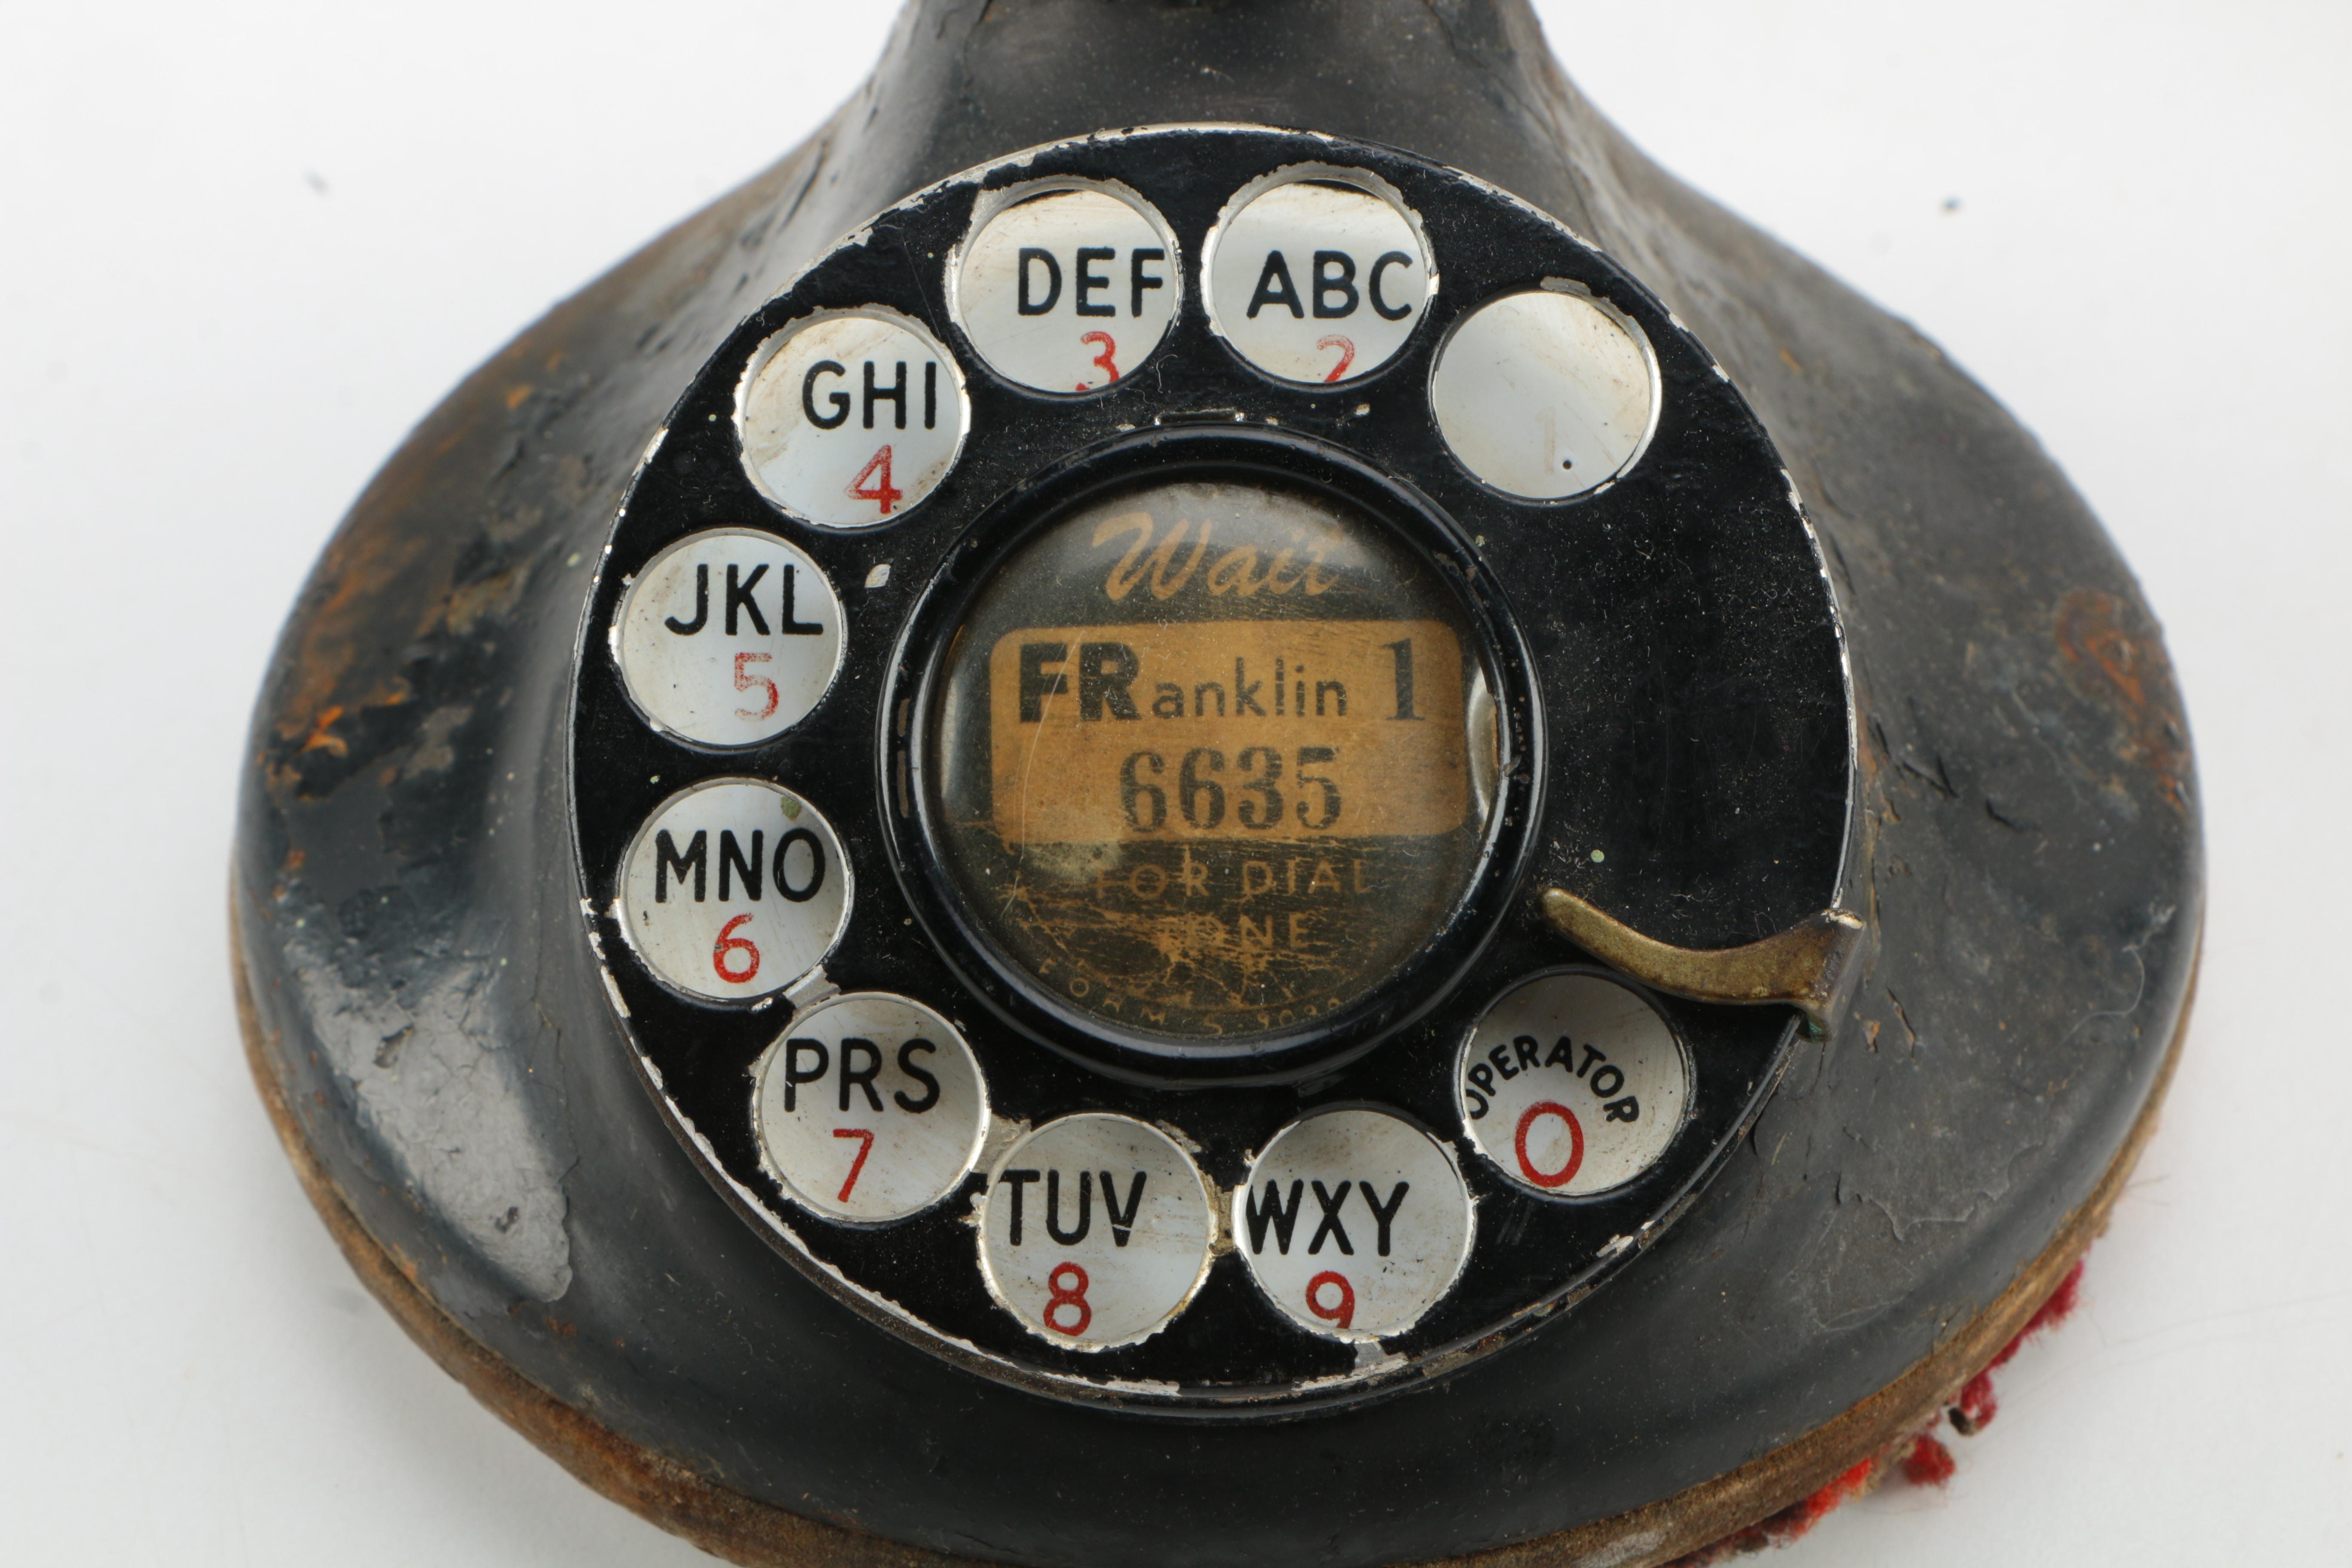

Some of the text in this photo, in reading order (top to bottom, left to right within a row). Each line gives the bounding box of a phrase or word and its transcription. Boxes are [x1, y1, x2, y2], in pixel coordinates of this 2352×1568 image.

[1018, 248, 1165, 318] DEF
[1246, 249, 1413, 321] ABC
[802, 360, 937, 429] GHI
[1080, 331, 1119, 391] 3
[1317, 334, 1354, 383] 2
[845, 444, 903, 514] 4
[1092, 512, 1339, 600] Wait
[664, 563, 824, 636] JKL
[734, 652, 779, 721] 5
[1020, 638, 1426, 723] FRanklin 1
[1120, 746, 1342, 832] 6635
[655, 828, 825, 903] MNO
[1243, 858, 1375, 895] DIAL
[713, 913, 760, 984] 6
[784, 1038, 940, 1113] PRS
[1465, 1035, 1640, 1123] OPERATOR
[833, 1128, 874, 1203] 7
[998, 1169, 1147, 1246] TUV
[1245, 1179, 1410, 1257] WXY
[1044, 1262, 1091, 1336] 8
[1305, 1270, 1355, 1329] 9
